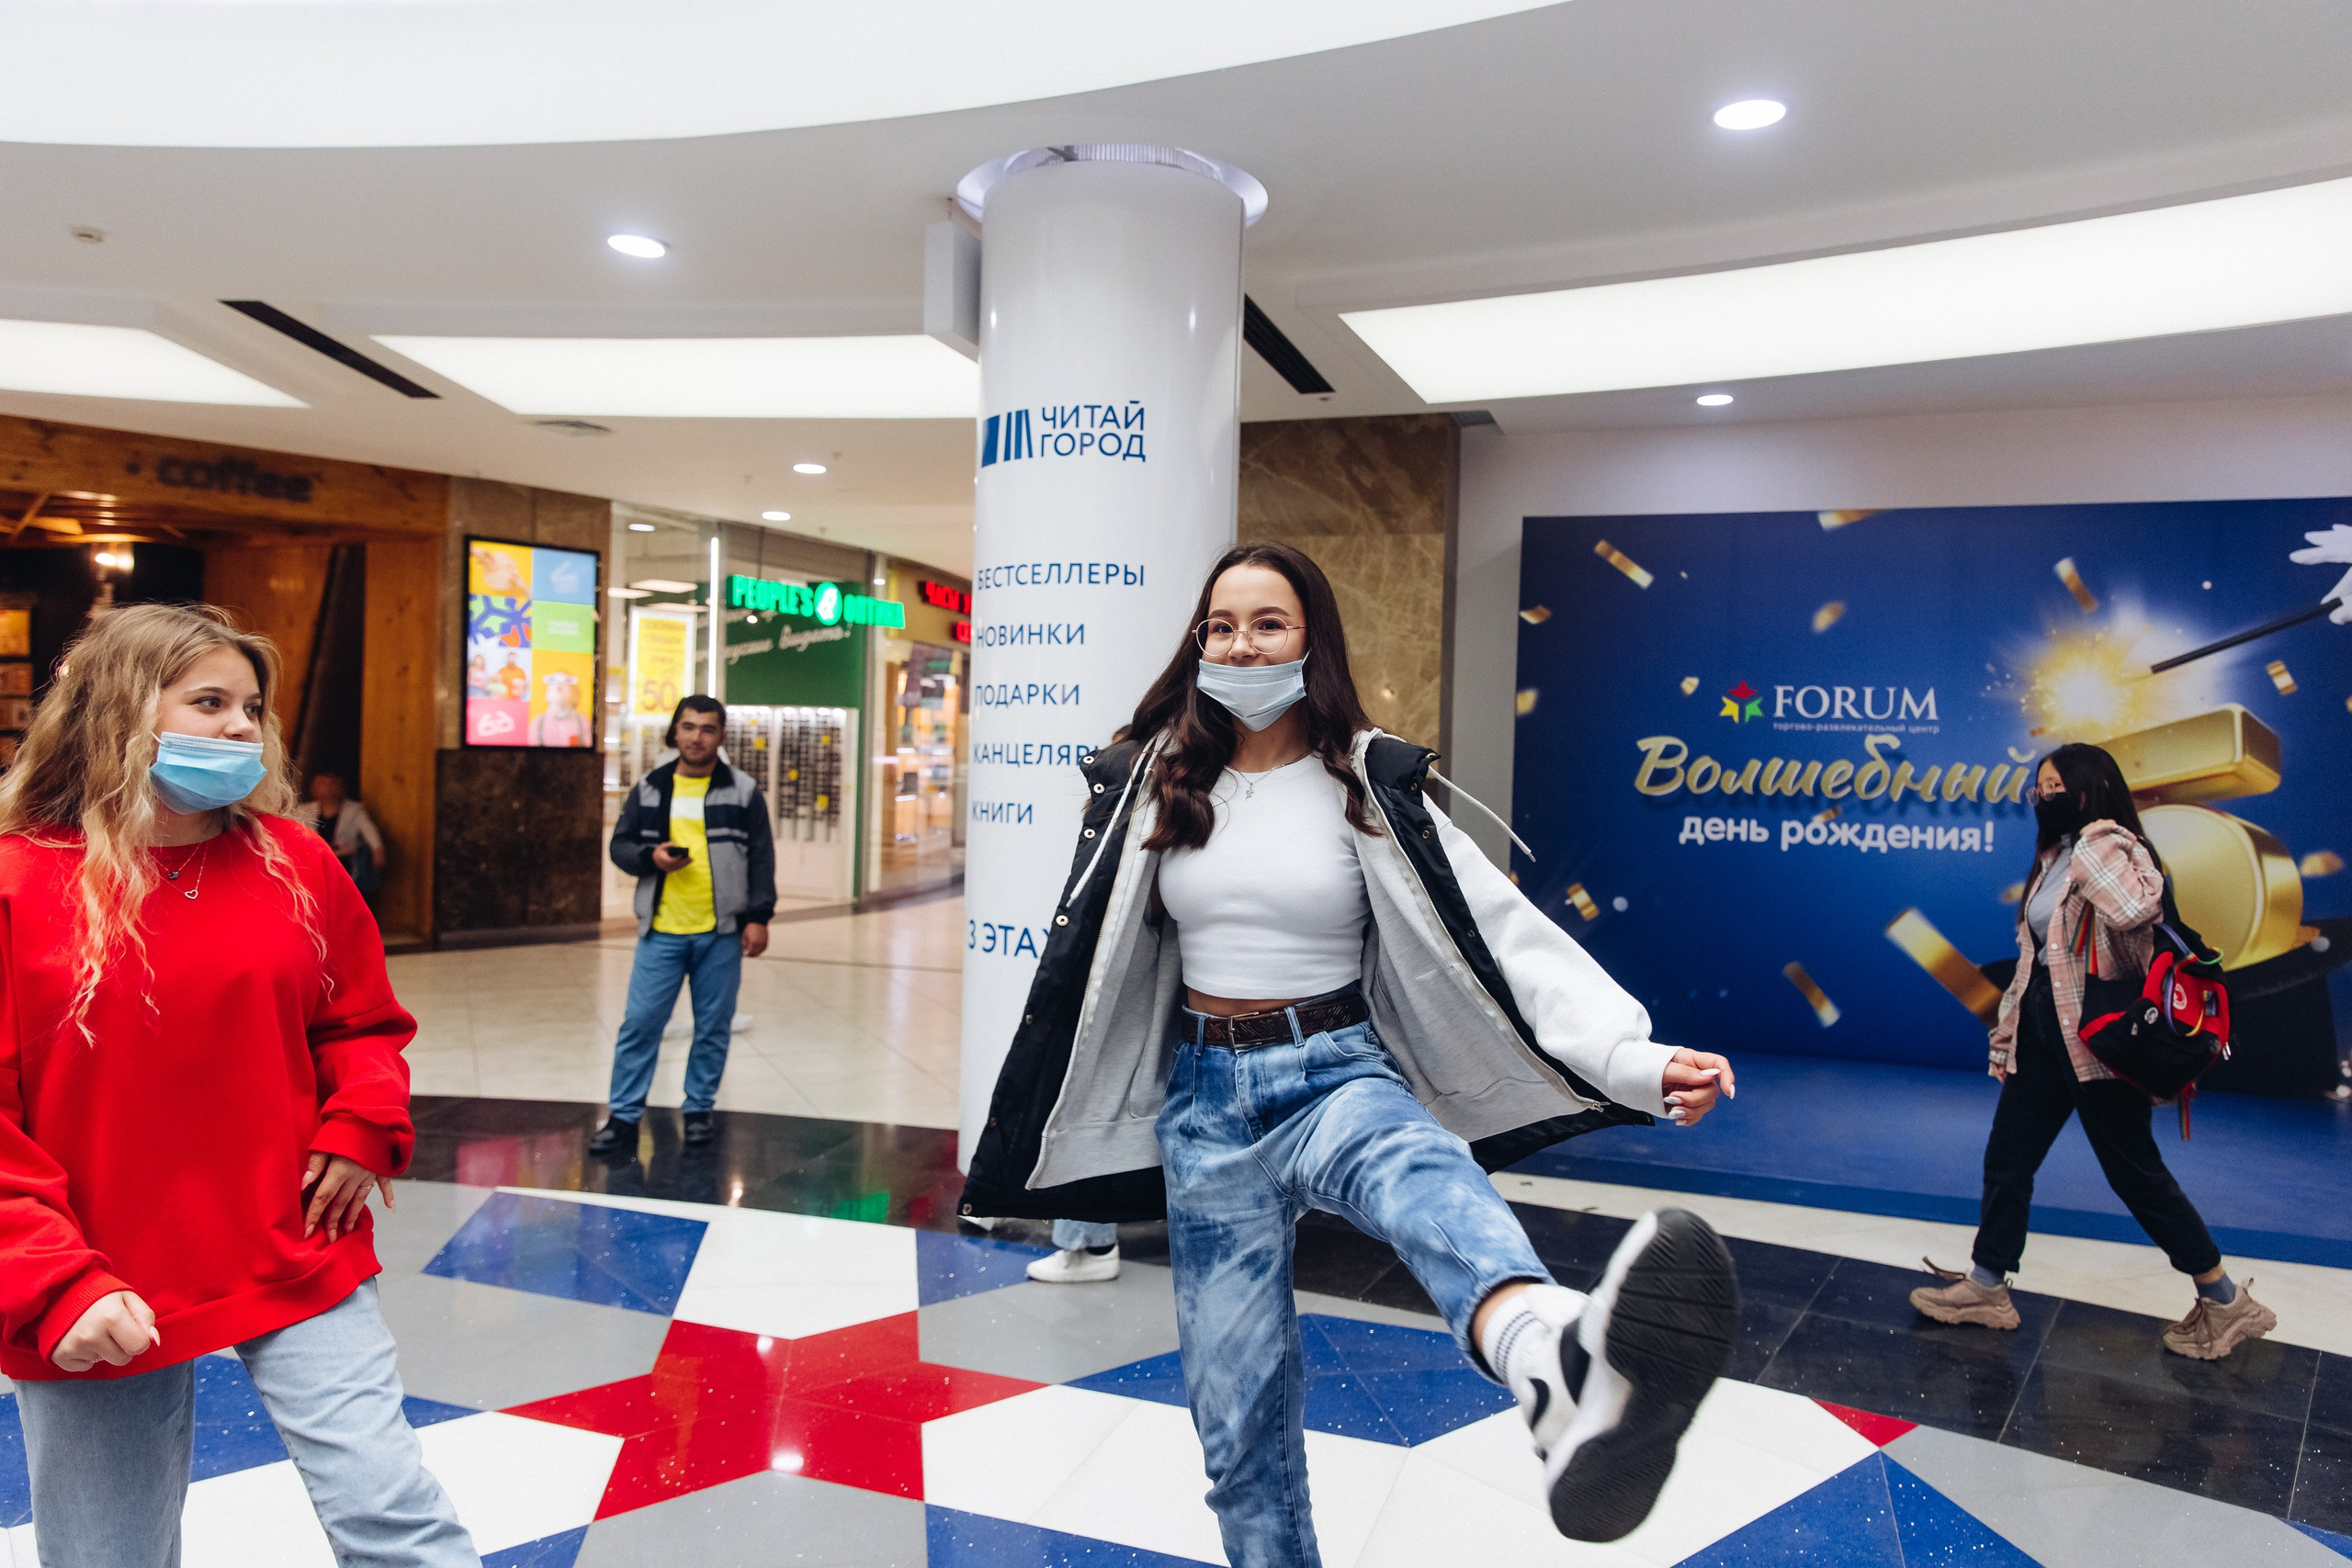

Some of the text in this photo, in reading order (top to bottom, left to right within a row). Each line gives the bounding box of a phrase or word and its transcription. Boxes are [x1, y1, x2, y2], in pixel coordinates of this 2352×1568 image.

[1041, 400, 1145, 431] ЧИТАЙ
[1040, 433, 1147, 462] ГОРОД
[978, 563, 1145, 591] БЕСТСЕЛЛЕРЫ
[976, 624, 1085, 648] НОВИНКИ
[974, 684, 1080, 708] ПОДАРКИ
[1773, 685, 1939, 720] FORUM
[972, 743, 1099, 768] КАНЦЕЛЯР
[1634, 734, 2037, 804] Волшебный
[971, 801, 1034, 825] КНИГИ
[1679, 816, 1996, 852] день рождения!
[968, 919, 1050, 958] 3 ЭТА
